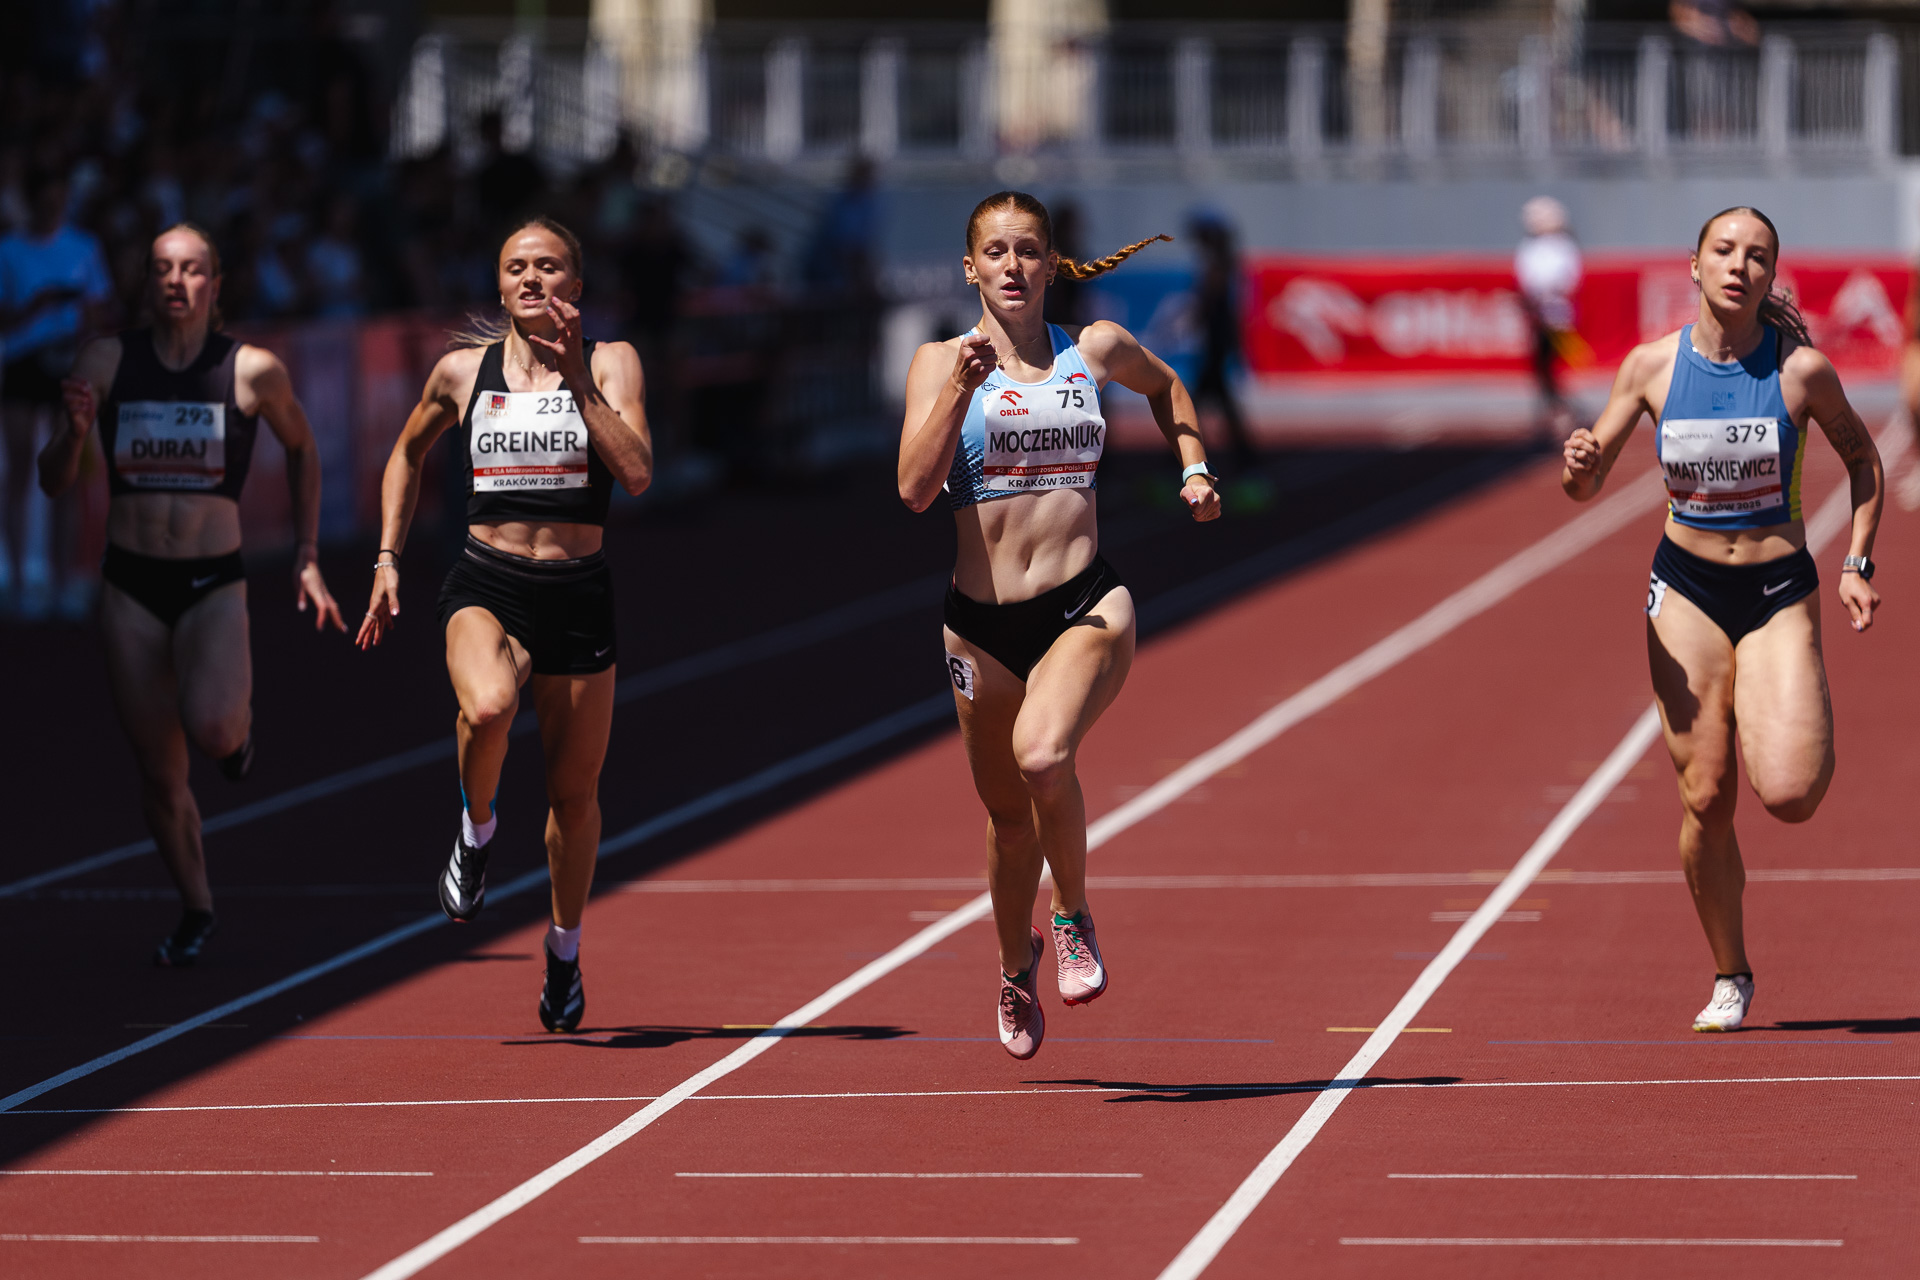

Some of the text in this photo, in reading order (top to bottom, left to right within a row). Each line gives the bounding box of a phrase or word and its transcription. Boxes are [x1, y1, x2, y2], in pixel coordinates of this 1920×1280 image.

[536, 396, 577, 415] 231
[1056, 389, 1085, 409] 75
[175, 406, 214, 426] 293
[1000, 408, 1029, 417] ORLEN
[477, 430, 580, 454] GREINER
[989, 425, 1103, 453] MOCZERNIUK
[1726, 424, 1767, 443] 379
[131, 438, 207, 459] DURAJ
[1007, 467, 1024, 475] PZLA
[1024, 466, 1063, 475] Mistrzostwa
[1064, 463, 1084, 471] Polski
[1666, 456, 1776, 481] MATYŚKIEWICZ
[493, 476, 565, 487] KRAKÓW 2025
[1008, 476, 1085, 487] KRAKÓW 2025
[1689, 500, 1762, 512] KRAKÓW 2025
[950, 657, 965, 690] 6
